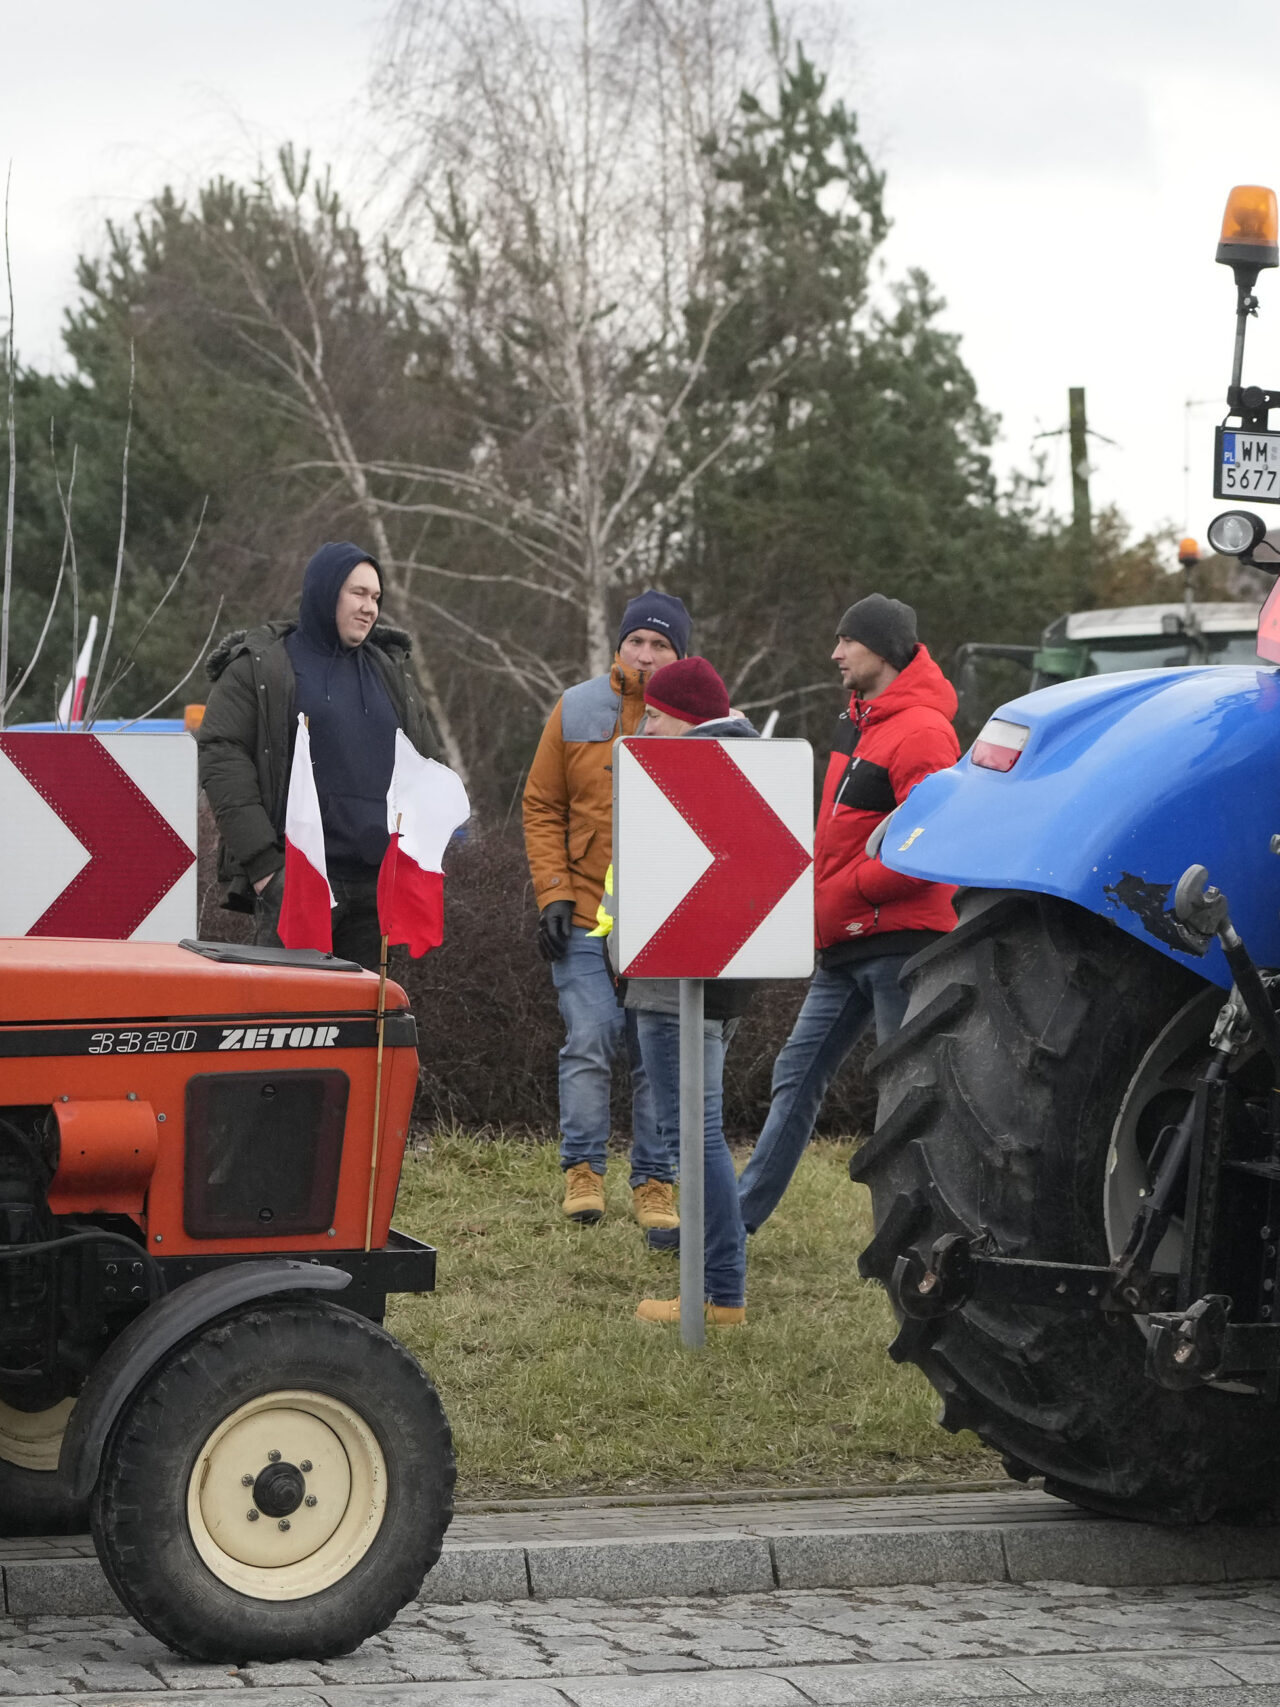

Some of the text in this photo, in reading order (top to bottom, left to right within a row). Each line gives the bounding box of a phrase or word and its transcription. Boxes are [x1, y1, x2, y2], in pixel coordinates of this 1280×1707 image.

[1224, 451, 1235, 462] PL
[1241, 441, 1268, 463] WM
[1226, 468, 1277, 491] 5677
[88, 1026, 340, 1054] 3320 ZETOR
